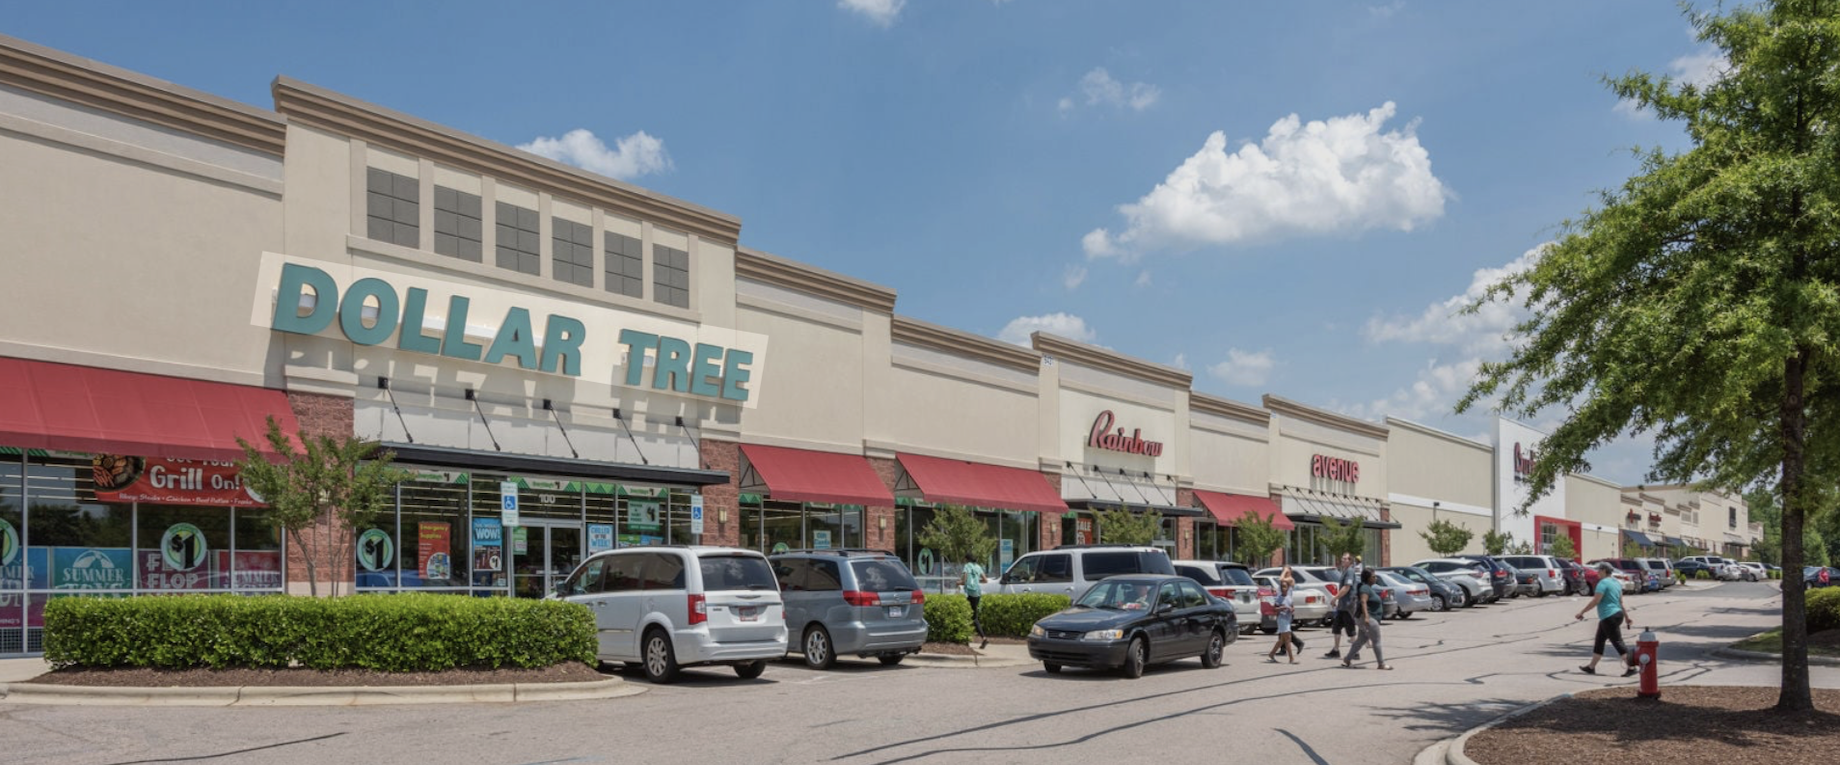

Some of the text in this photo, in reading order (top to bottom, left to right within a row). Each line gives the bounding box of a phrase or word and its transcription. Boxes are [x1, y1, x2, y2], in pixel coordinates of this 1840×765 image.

[271, 262, 754, 402] DOLLAR TREE
[1088, 410, 1163, 457] Rainbow
[150, 465, 240, 490] Grill On!
[1311, 454, 1360, 484] avenue
[539, 494, 556, 504] 100
[475, 527, 500, 540] WOW!
[170, 533, 195, 569] $1
[364, 538, 385, 569] $1
[63, 567, 124, 582] SUMMER
[147, 573, 199, 589] FLOP
